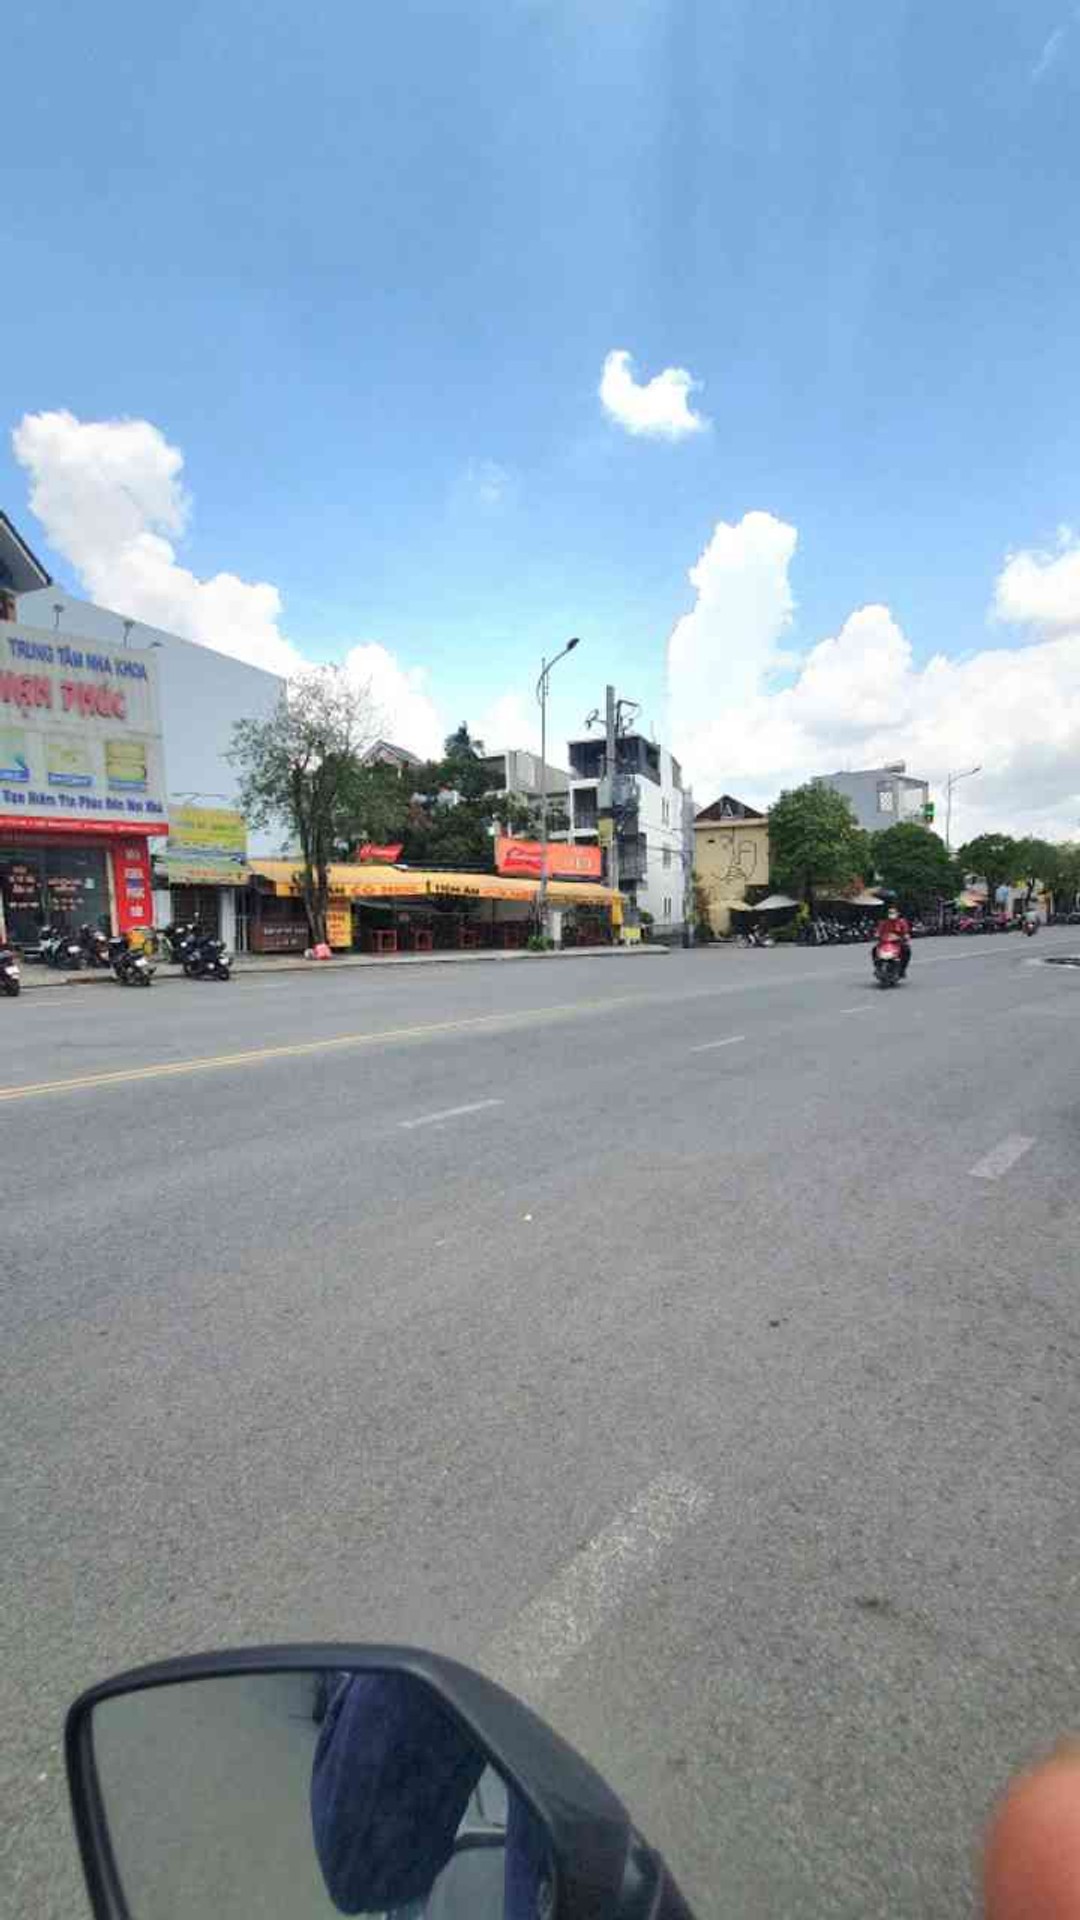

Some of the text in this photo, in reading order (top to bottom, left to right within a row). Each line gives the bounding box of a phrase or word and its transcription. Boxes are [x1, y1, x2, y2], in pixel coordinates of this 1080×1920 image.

[8, 636, 147, 682] TRUNG TÂM NHA KHOA
